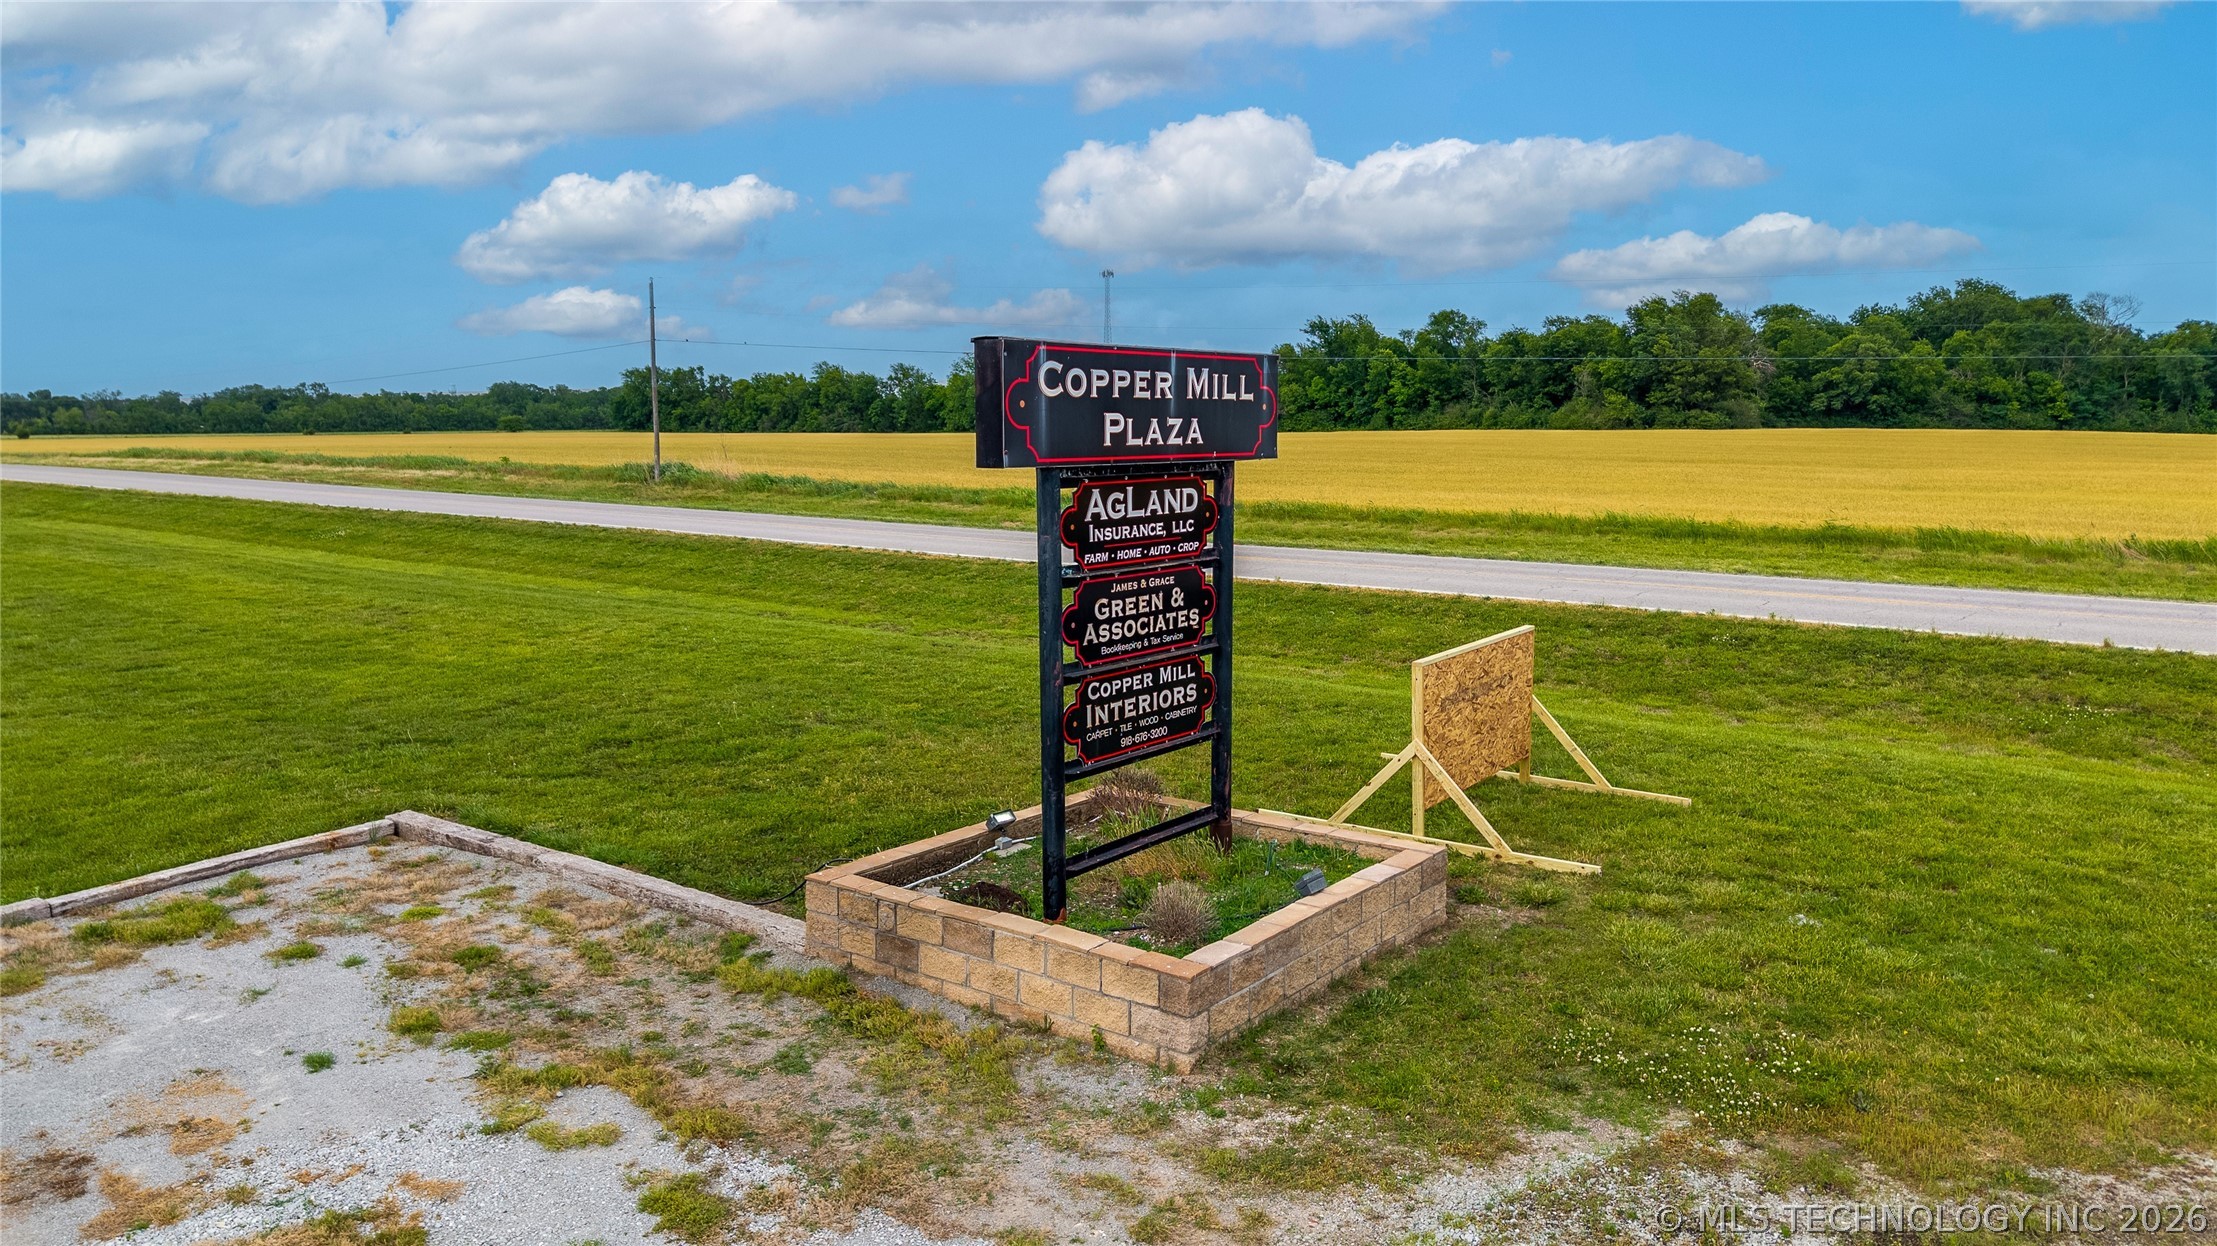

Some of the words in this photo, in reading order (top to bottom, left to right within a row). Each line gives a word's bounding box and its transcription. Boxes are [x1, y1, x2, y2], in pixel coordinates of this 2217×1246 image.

[1037, 360, 1174, 400] COPPER
[1186, 367, 1255, 401] MILL
[1103, 412, 1204, 446] PLAZA
[1088, 522, 1167, 543] INSURANCE,
[1172, 519, 1195, 534] LLC
[1084, 552, 1109, 564] FARM
[1116, 547, 1142, 560] HOME
[1148, 544, 1171, 556] AUTO
[1177, 541, 1200, 553] CROP
[1110, 581, 1138, 593] JAMES
[1140, 579, 1147, 588] &
[1148, 576, 1175, 587] GRACE
[1094, 590, 1164, 620] GREEN
[1170, 587, 1184, 607] &
[1082, 608, 1200, 646] ASSOCIATES
[1143, 638, 1149, 647] &
[1150, 635, 1161, 645] Tax
[1162, 632, 1184, 643] Service
[1087, 672, 1153, 701] COPPER
[1159, 663, 1196, 685] MILL
[1086, 683, 1198, 729] INTERIORS
[1086, 727, 1114, 742] CARPET
[1119, 722, 1133, 733] TILE
[1138, 715, 1159, 727] WOOD
[1164, 705, 1198, 721] CABINETRY
